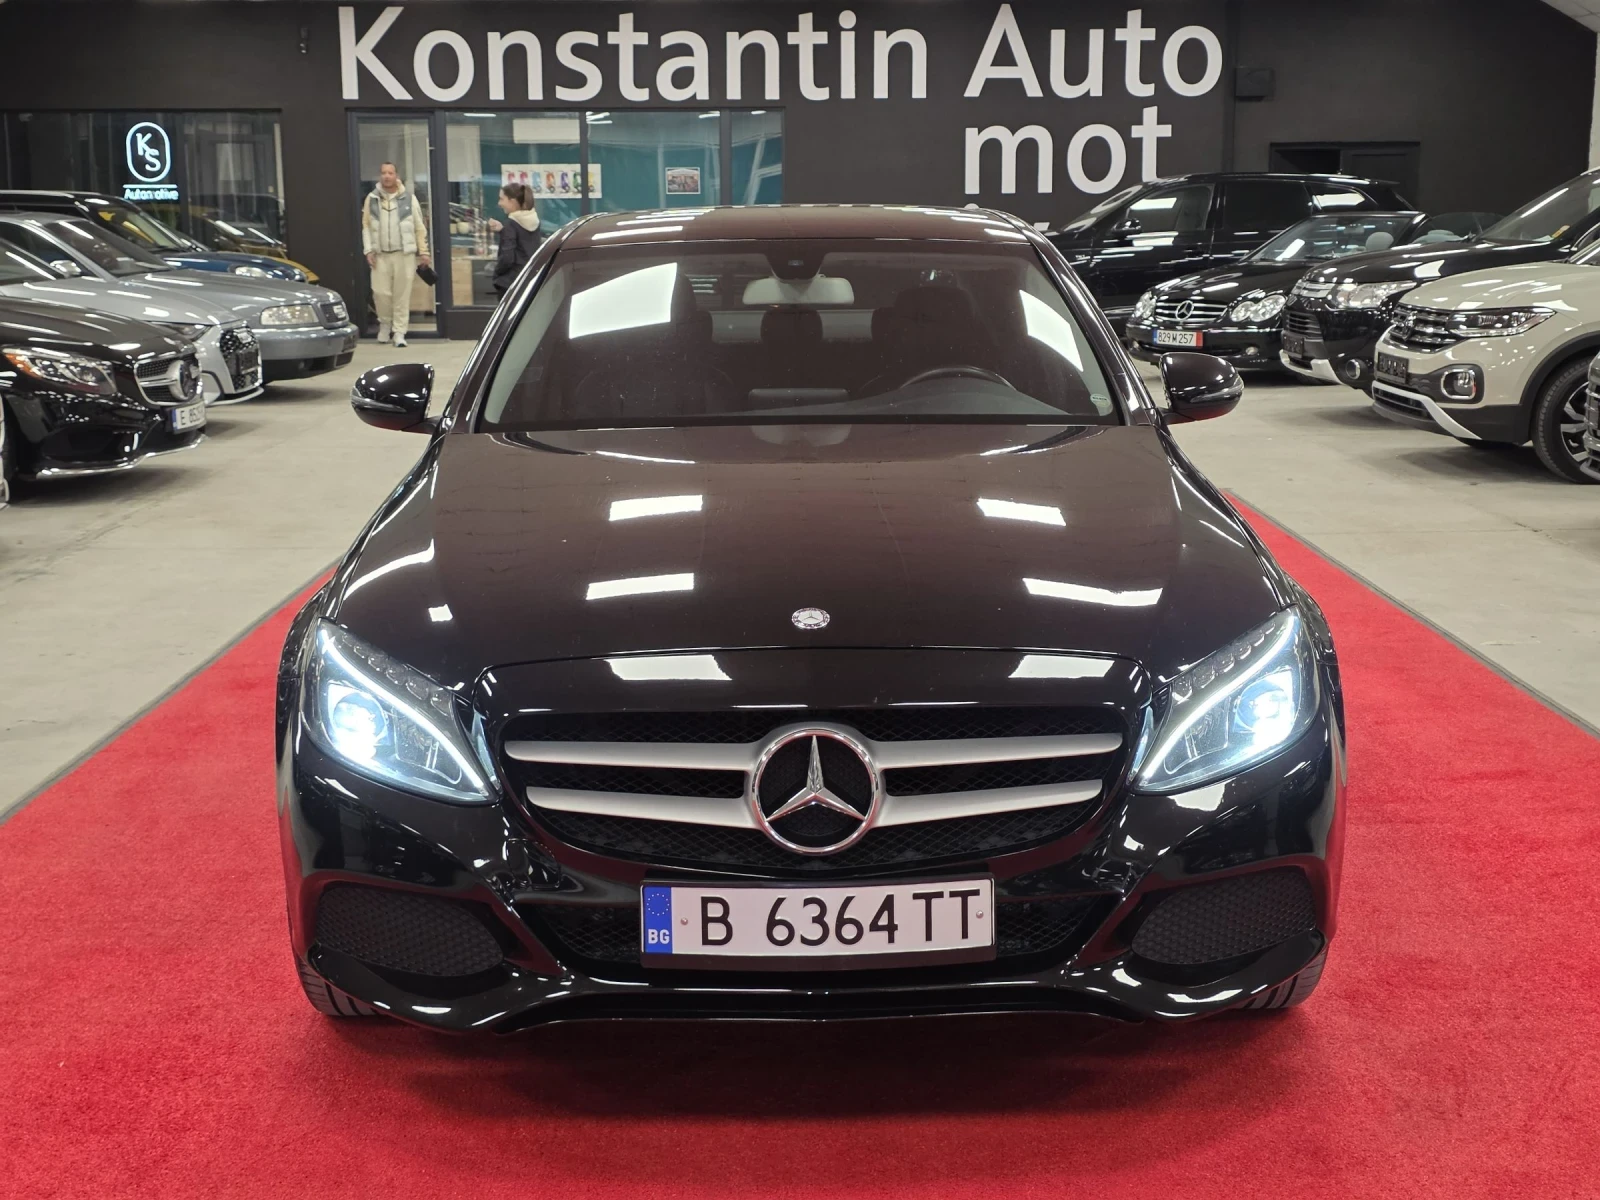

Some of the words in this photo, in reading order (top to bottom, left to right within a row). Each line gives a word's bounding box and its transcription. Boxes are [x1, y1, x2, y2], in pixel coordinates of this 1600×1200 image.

[338, 6, 927, 102] Konstantin
[963, 3, 1223, 98] Auto
[964, 105, 1172, 194] mot
[1158, 331, 1171, 343] 829
[1172, 333, 1178, 343] M
[1178, 333, 1194, 344] 257
[647, 929, 670, 945] BG
[700, 896, 733, 946] B
